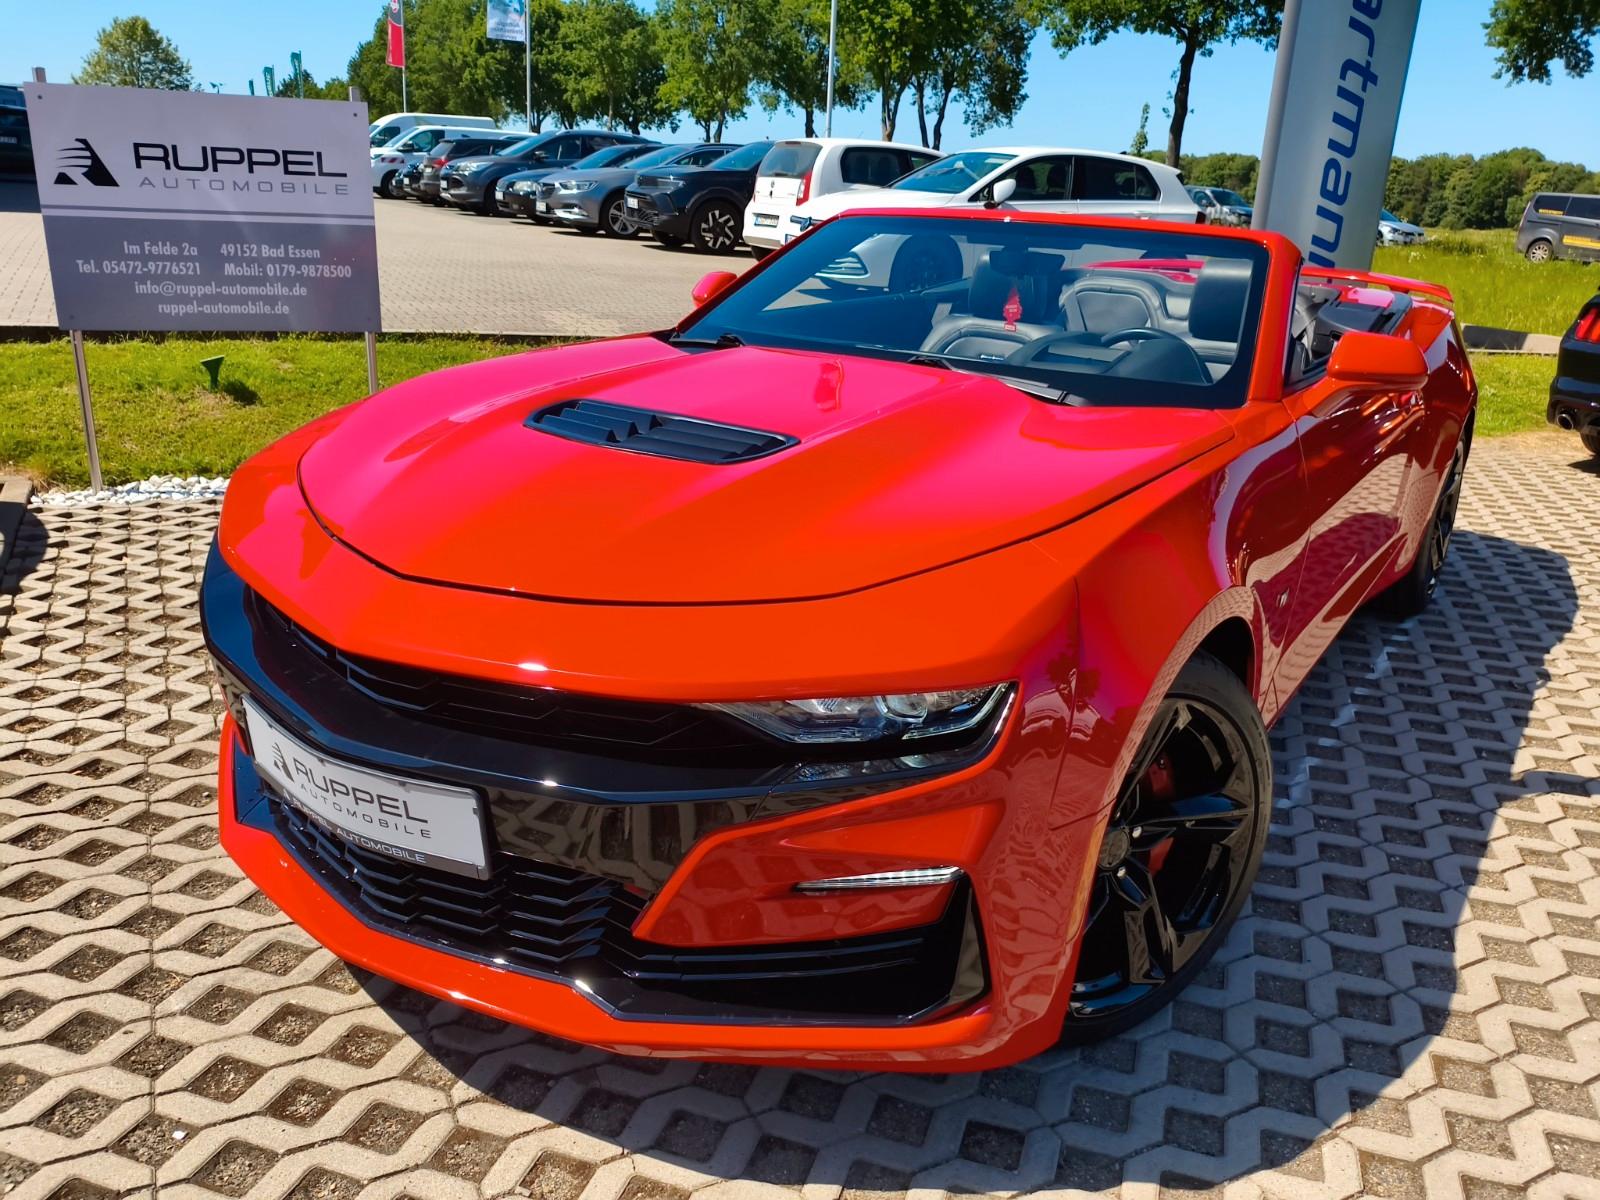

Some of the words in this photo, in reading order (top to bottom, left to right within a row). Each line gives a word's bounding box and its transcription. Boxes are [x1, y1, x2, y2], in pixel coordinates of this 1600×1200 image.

[132, 142, 348, 178] RUPPEL
[138, 176, 350, 196] AUTOMOBILE
[123, 241, 141, 255] Im
[143, 241, 179, 256] Felde
[181, 242, 198, 256] 2a
[219, 243, 258, 257] 49152
[261, 244, 285, 258] Bad
[287, 245, 321, 259] Essen
[76, 259, 100, 273] Tel.
[102, 260, 201, 275] 05472-9776521
[224, 262, 263, 277] Mobil:
[265, 263, 352, 278] 0179-9878500
[134, 280, 308, 297] info@ruppel-automobile.de
[158, 300, 290, 316] ruppel-automobile.de
[292, 757, 429, 824] RUPPEL
[300, 783, 432, 839] AUTOMOBILE
[336, 827, 427, 864] AUTOMOBILE
